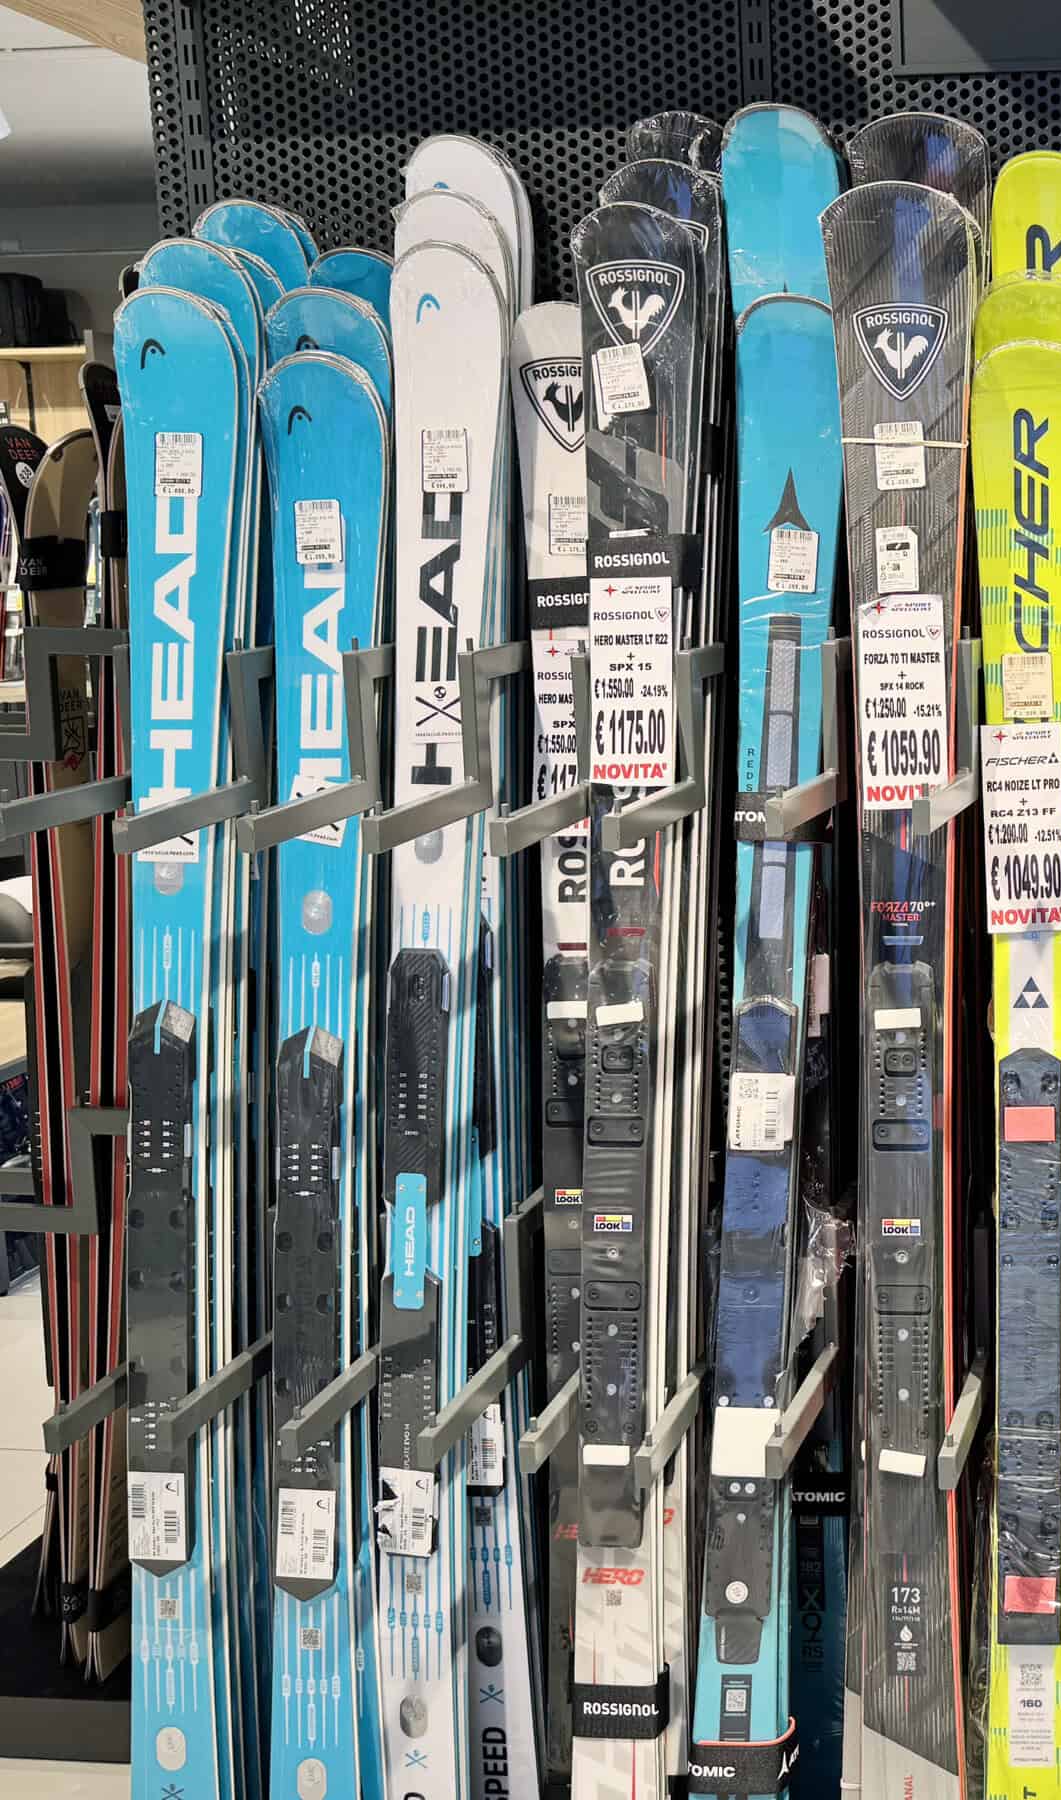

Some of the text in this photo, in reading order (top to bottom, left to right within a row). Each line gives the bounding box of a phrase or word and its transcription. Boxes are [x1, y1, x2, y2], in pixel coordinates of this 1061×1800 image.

[598, 268, 672, 286] ROSSIGNOL
[866, 312, 935, 329] ROSSIGNOL
[595, 552, 670, 568] ROSSIGNOL
[593, 611, 654, 621] ROSSIGNOL
[594, 633, 668, 646] HERO MASTER LT R22
[862, 628, 926, 639] ROSSIGNOL
[864, 651, 940, 665] FORZA 70 TI MASTER
[610, 663, 652, 672] SPX 15
[880, 681, 925, 691] SPX 14 ROCK
[539, 694, 556, 704] HERO
[608, 709, 667, 755] 1175.00
[881, 729, 941, 777] 1059.90
[985, 755, 1048, 767] FISCHER
[593, 763, 667, 779] NOVITA'
[986, 778, 1060, 792] RC4 NOIZE LT PRO
[990, 807, 1057, 818] RC4 Z13 FF
[1004, 853, 1061, 900] 1049.90
[881, 912, 920, 923] MASTER
[595, 1222, 620, 1230] LOOK
[884, 1226, 909, 1235] LOOK
[405, 1206, 415, 1277] HEAD
[582, 1568, 644, 1585] HERO
[891, 1587, 920, 1603] 173
[583, 1702, 659, 1716] ROSSIGNOL
[1020, 1699, 1042, 1708] 160
